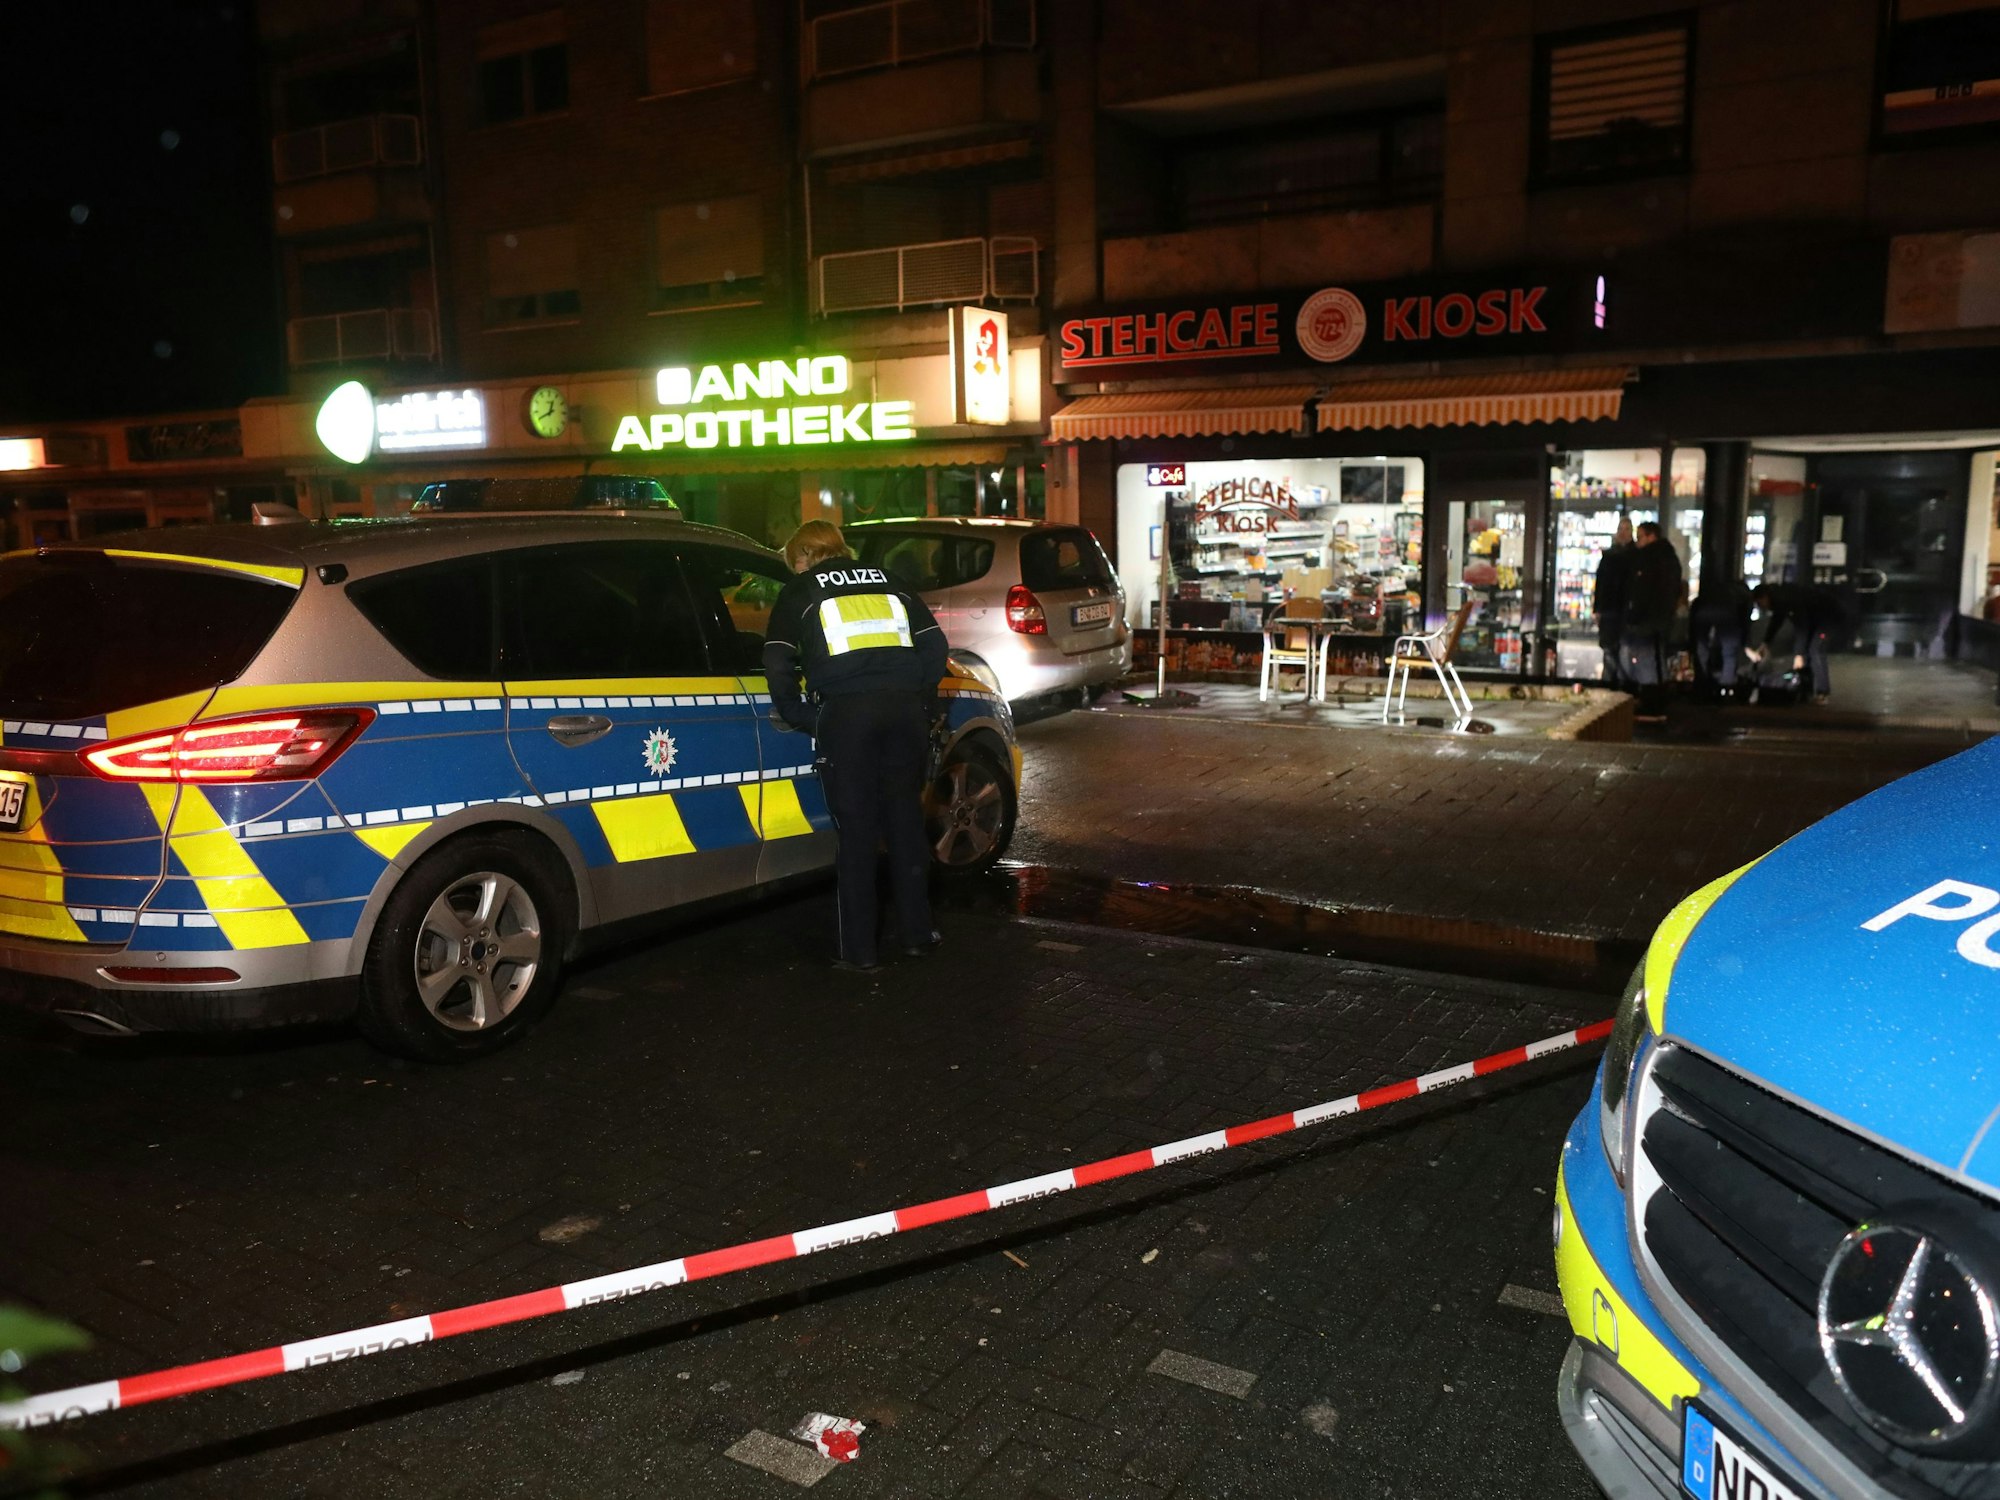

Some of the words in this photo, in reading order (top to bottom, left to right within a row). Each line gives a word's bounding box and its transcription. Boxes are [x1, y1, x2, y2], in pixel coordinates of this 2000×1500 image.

[1061, 303, 1280, 362] STEHCAFE
[1384, 286, 1548, 341] KIOSK
[691, 355, 848, 403] ANNO
[611, 400, 914, 452] APOTHEKE
[1196, 477, 1298, 519] STEHCAFE
[1215, 515, 1279, 532] KIOSK
[816, 568, 888, 588] POLIZEI
